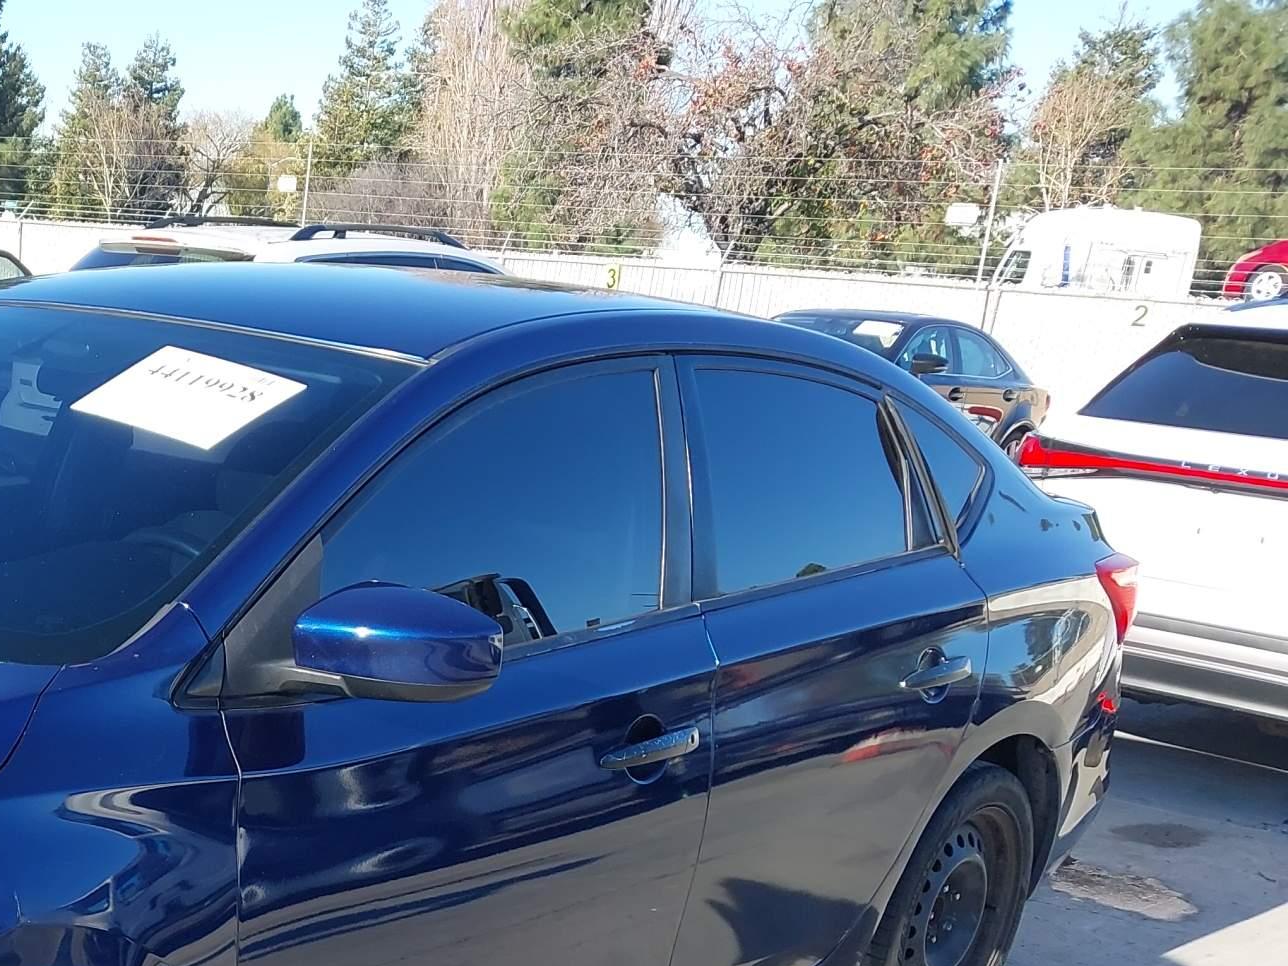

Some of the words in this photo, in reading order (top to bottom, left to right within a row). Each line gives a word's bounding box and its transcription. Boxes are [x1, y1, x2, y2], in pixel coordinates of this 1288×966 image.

[606, 268, 617, 289] 3
[1131, 304, 1149, 327] 2
[148, 364, 264, 402] 44119928
